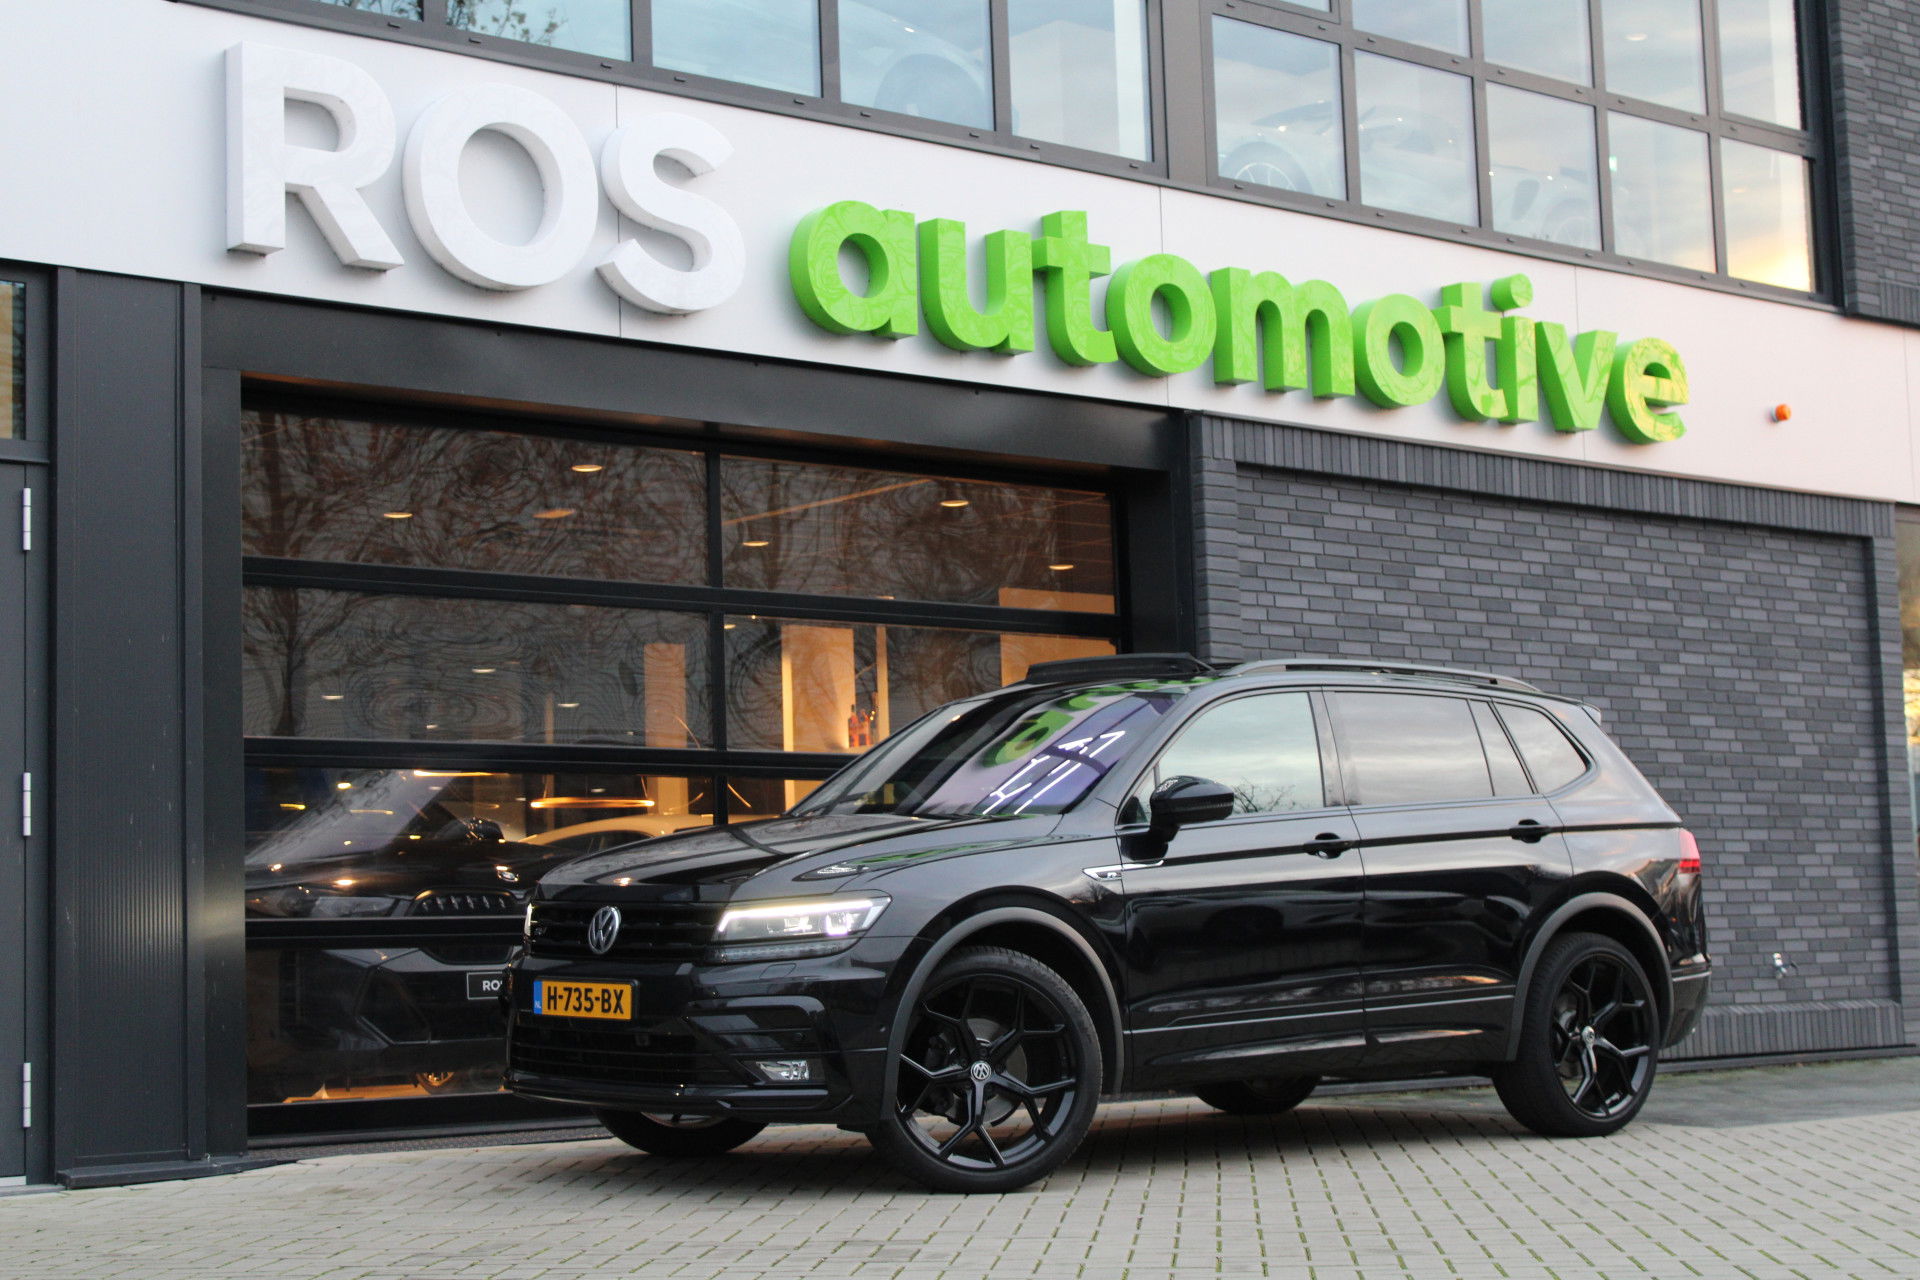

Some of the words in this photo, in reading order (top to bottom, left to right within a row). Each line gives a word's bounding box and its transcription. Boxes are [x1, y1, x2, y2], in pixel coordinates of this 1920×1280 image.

[225, 41, 746, 315] ROS
[788, 200, 1690, 445] automotive
[482, 979, 503, 991] RO
[547, 985, 624, 1014] H-735-BX
